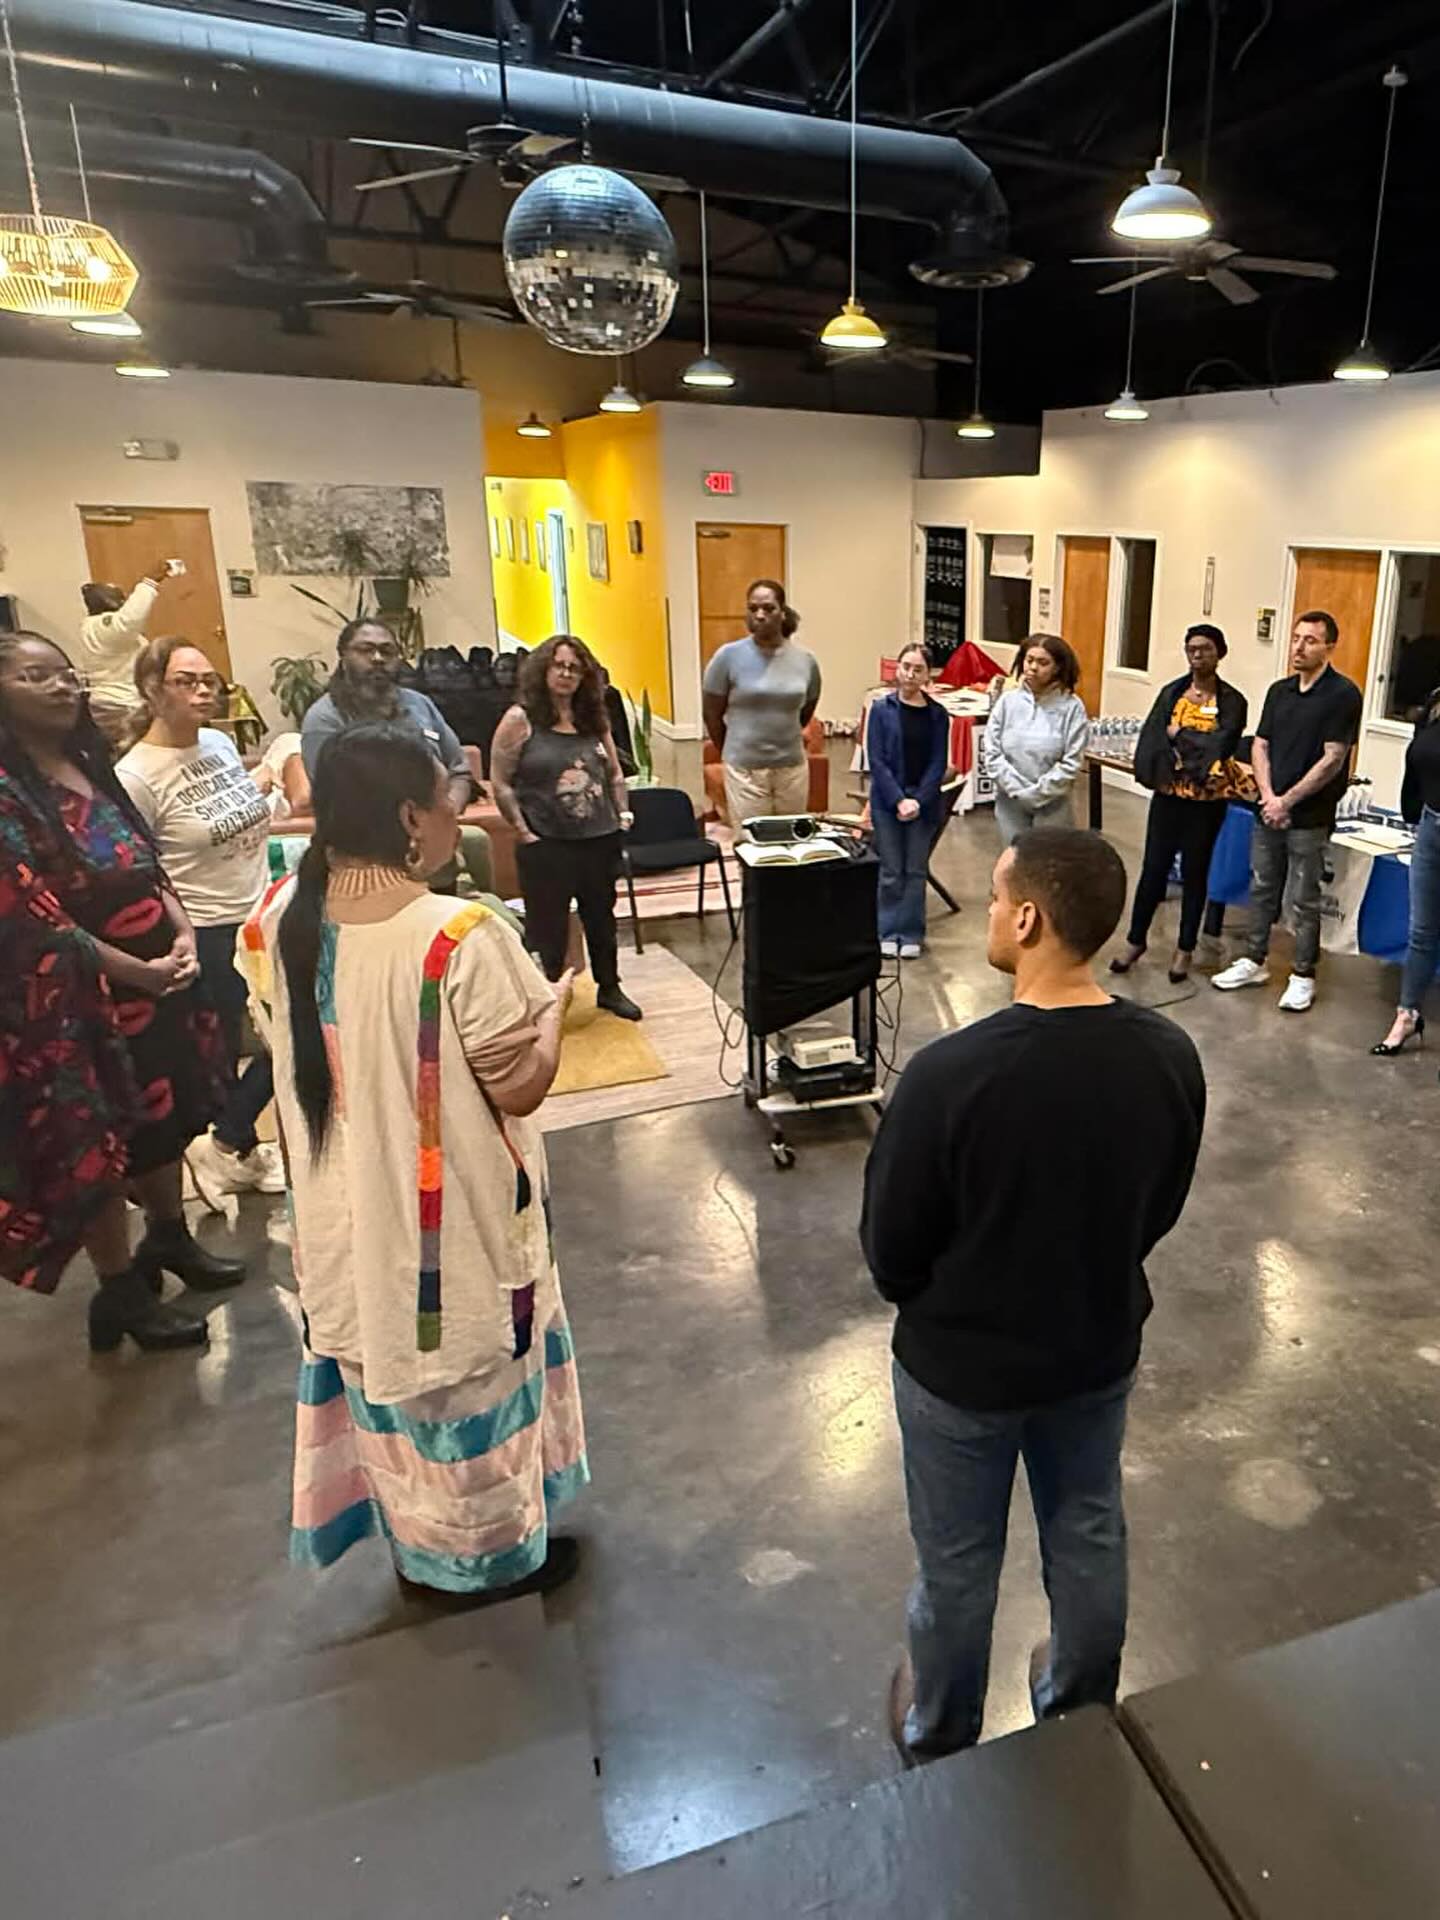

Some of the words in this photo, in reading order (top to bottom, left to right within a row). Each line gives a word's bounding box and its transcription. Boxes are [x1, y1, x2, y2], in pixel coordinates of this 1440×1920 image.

[176, 774, 233, 805] DEDICATE
[195, 796, 231, 821] SHIRT
[227, 789, 247, 807] TO
